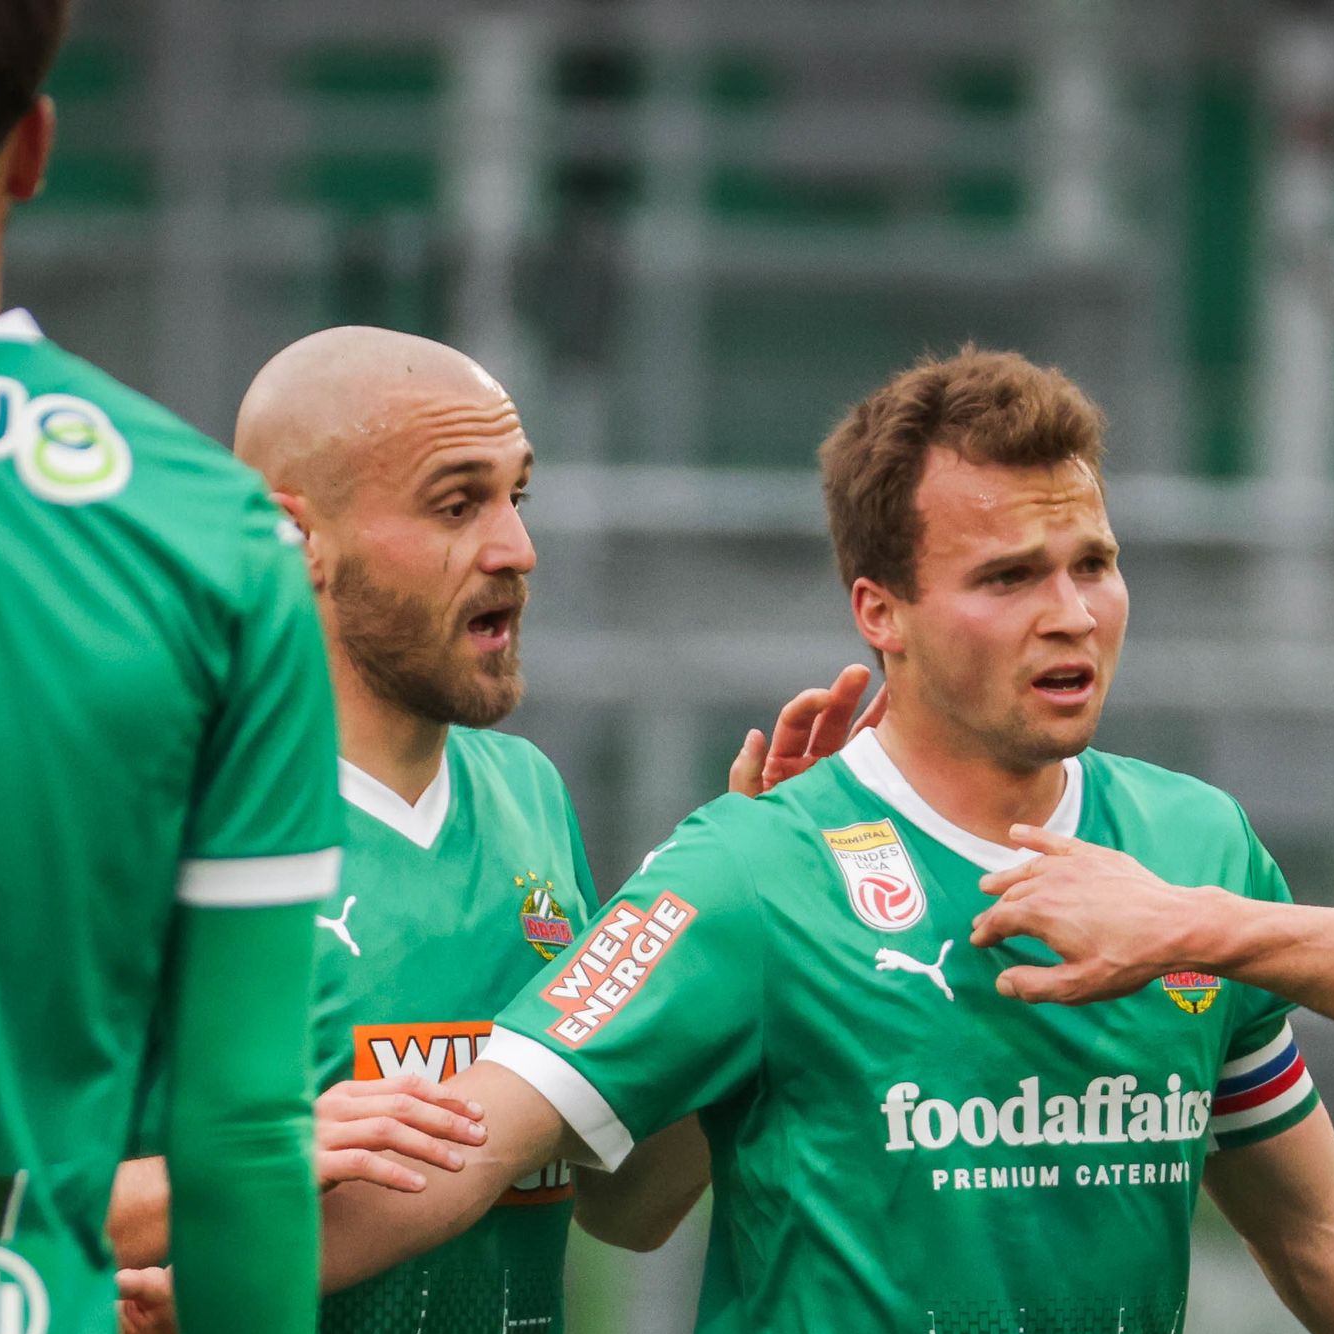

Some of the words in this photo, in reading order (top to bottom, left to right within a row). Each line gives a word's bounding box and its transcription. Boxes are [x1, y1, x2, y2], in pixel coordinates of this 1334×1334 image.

[829, 830, 891, 846] ADMIRAL
[837, 846, 900, 862] BUNDES
[855, 860, 891, 872] LIGA
[547, 907, 643, 999] WIEN
[554, 898, 690, 1043] ENERGIE
[880, 1073, 1212, 1151] foodaffairs
[932, 1165, 1060, 1191] PREMIUM
[1075, 1161, 1191, 1187] CATERIN
